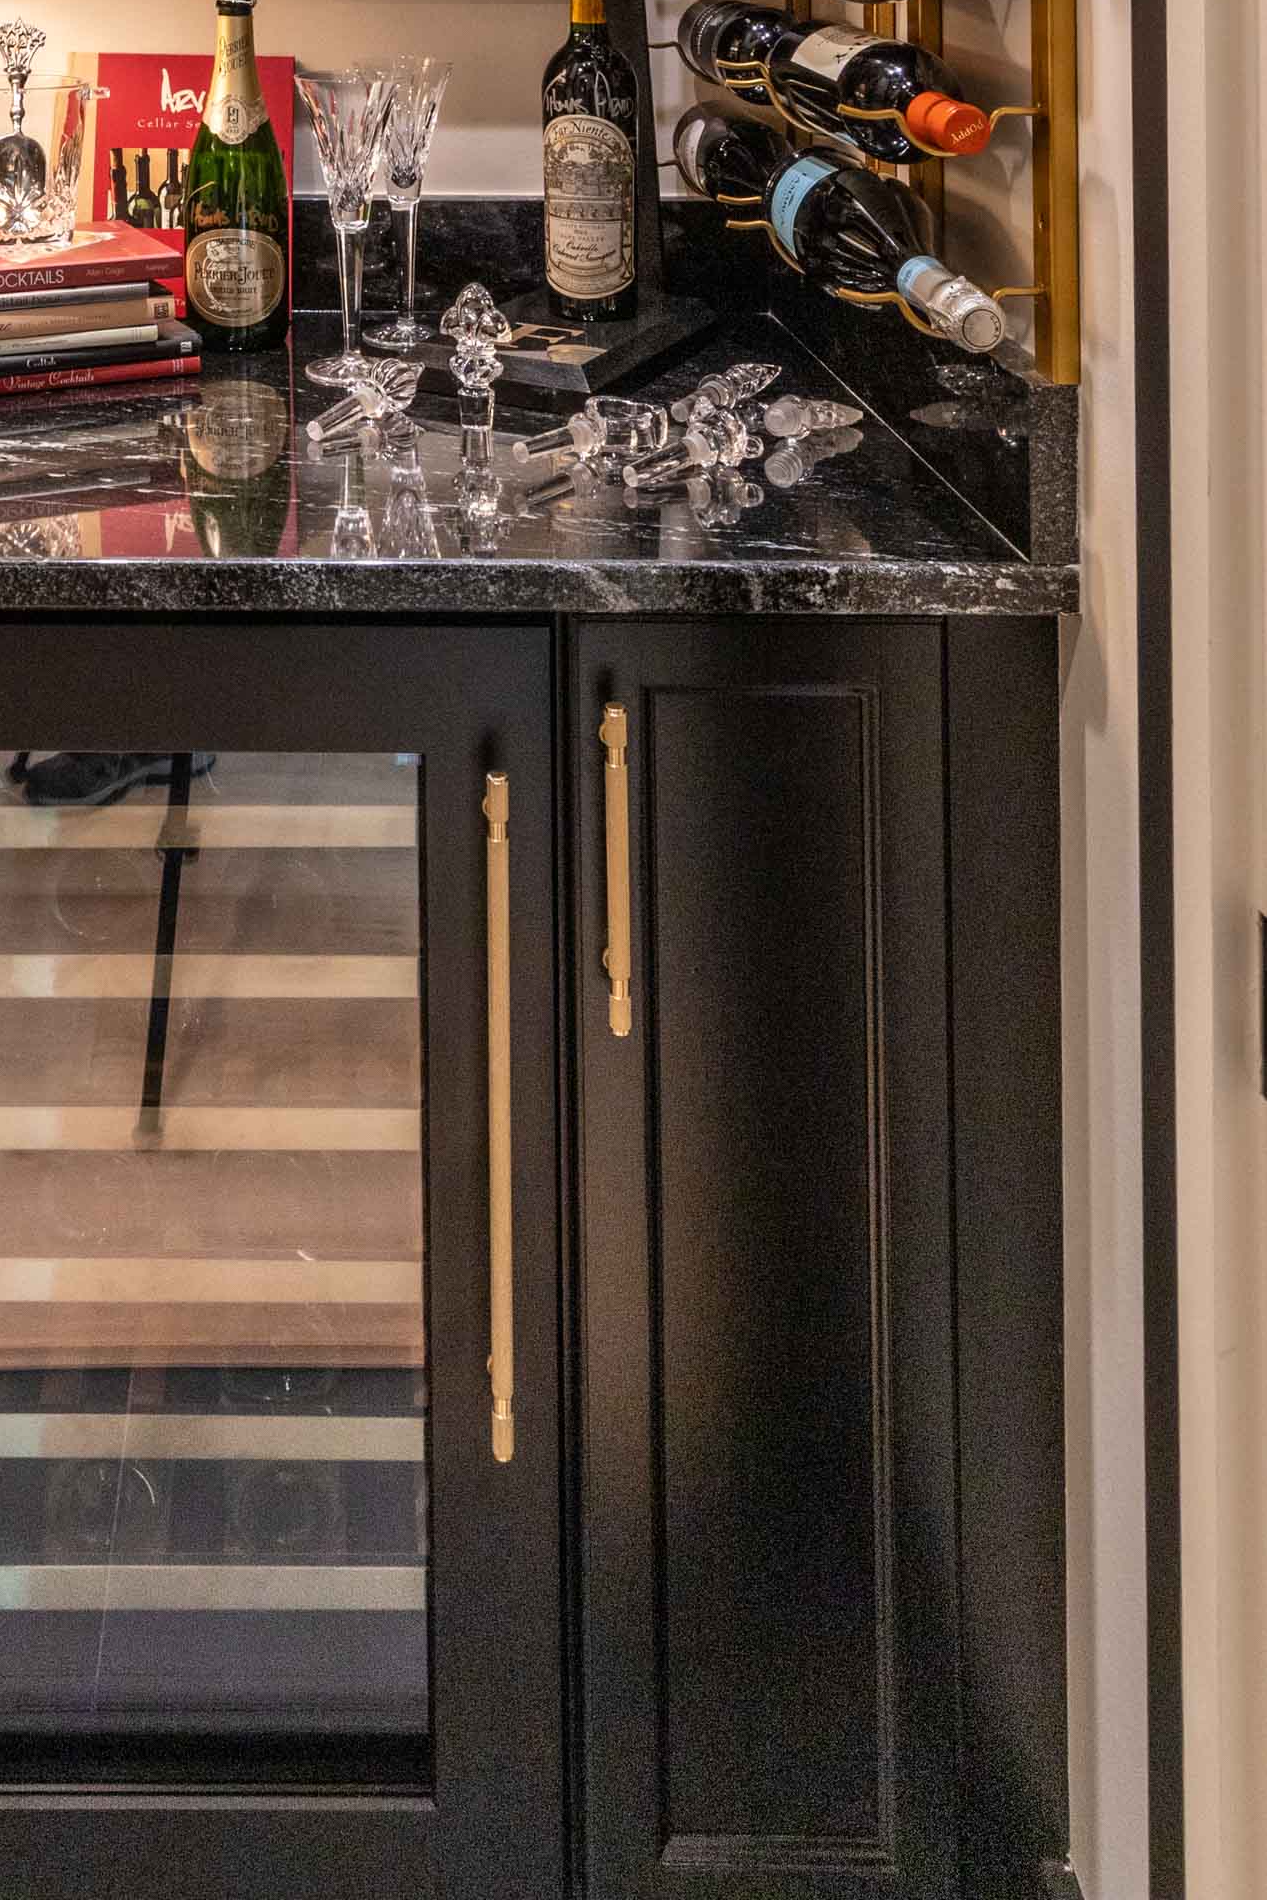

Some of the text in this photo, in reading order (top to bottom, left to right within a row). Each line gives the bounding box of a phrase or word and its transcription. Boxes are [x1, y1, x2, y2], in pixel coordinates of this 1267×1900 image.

[137, 117, 179, 129] Cellar
[570, 119, 610, 139] Niente
[950, 117, 985, 145] POPPY
[2, 375, 46, 392] Vintage
[48, 367, 95, 387] Cocktails
